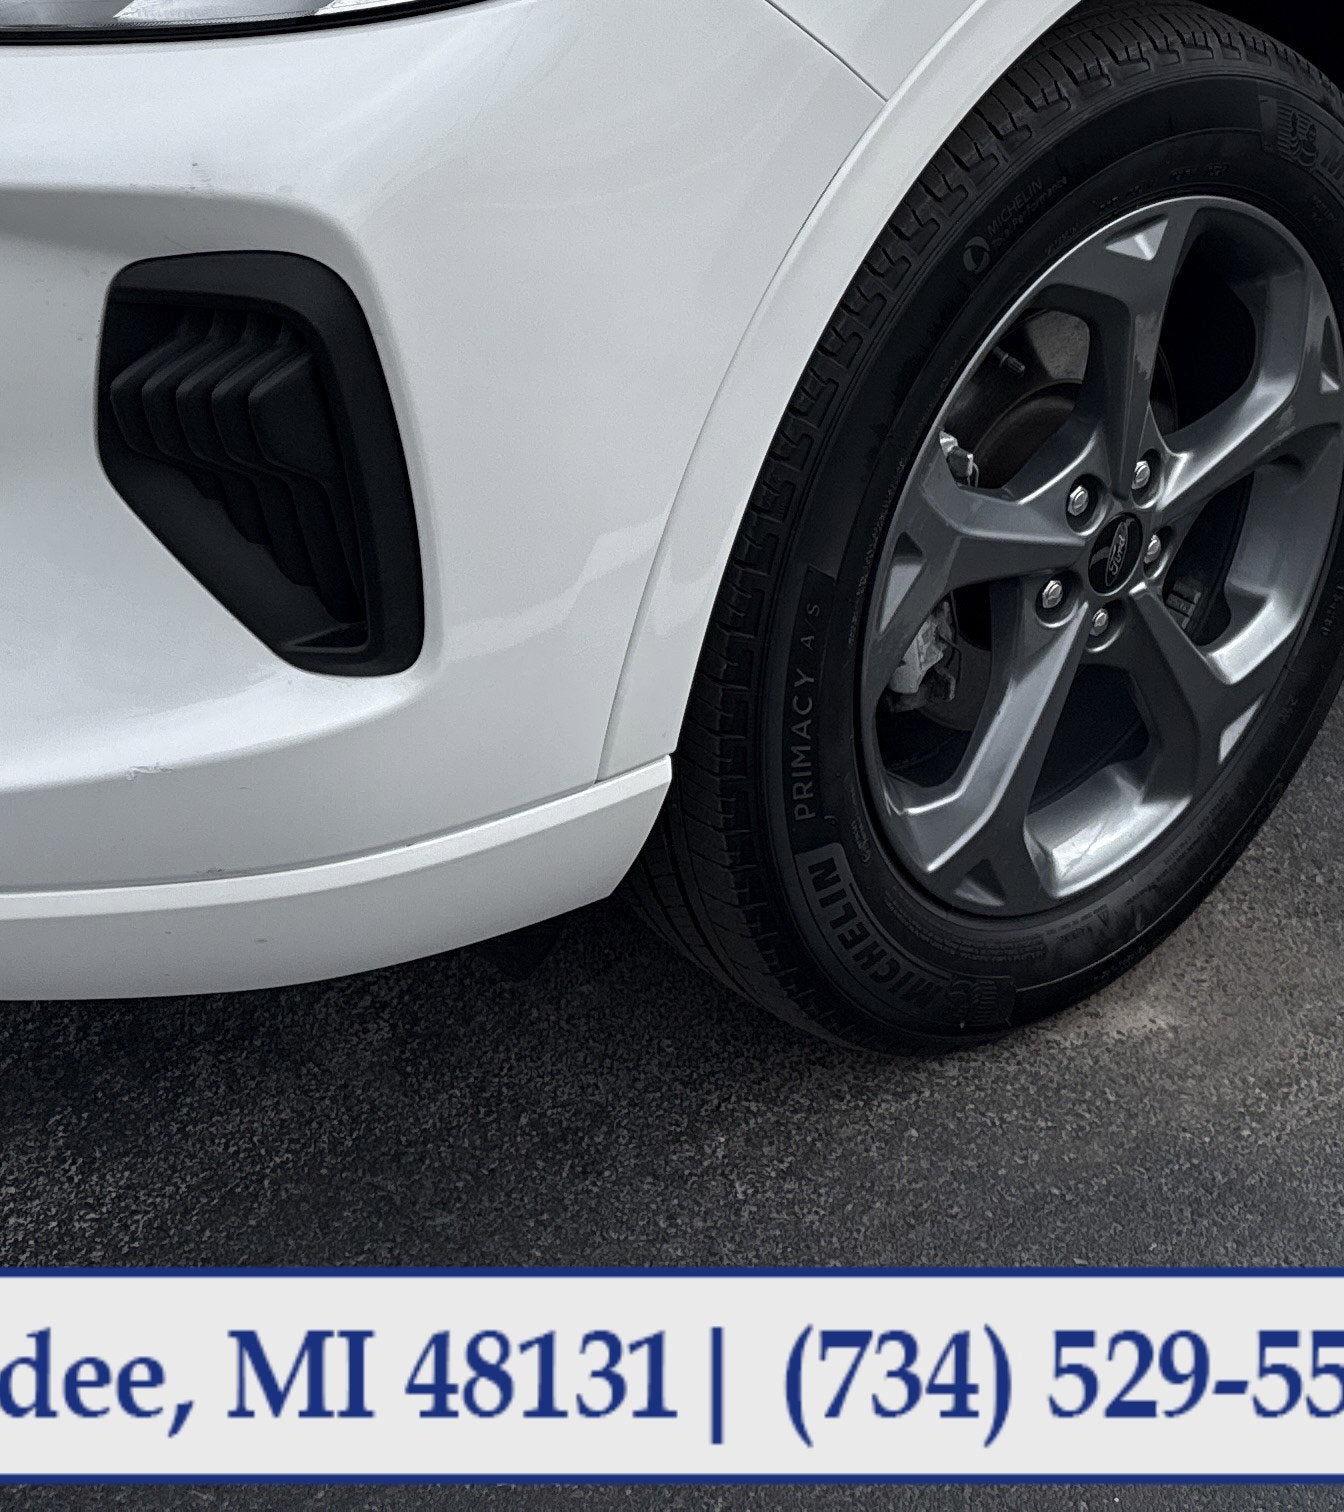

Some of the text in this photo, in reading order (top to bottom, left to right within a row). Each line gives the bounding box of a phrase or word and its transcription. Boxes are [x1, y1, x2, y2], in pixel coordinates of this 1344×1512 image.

[790, 603, 821, 823] PRIMACY A/S
[807, 856, 938, 1010] MICHELIN
